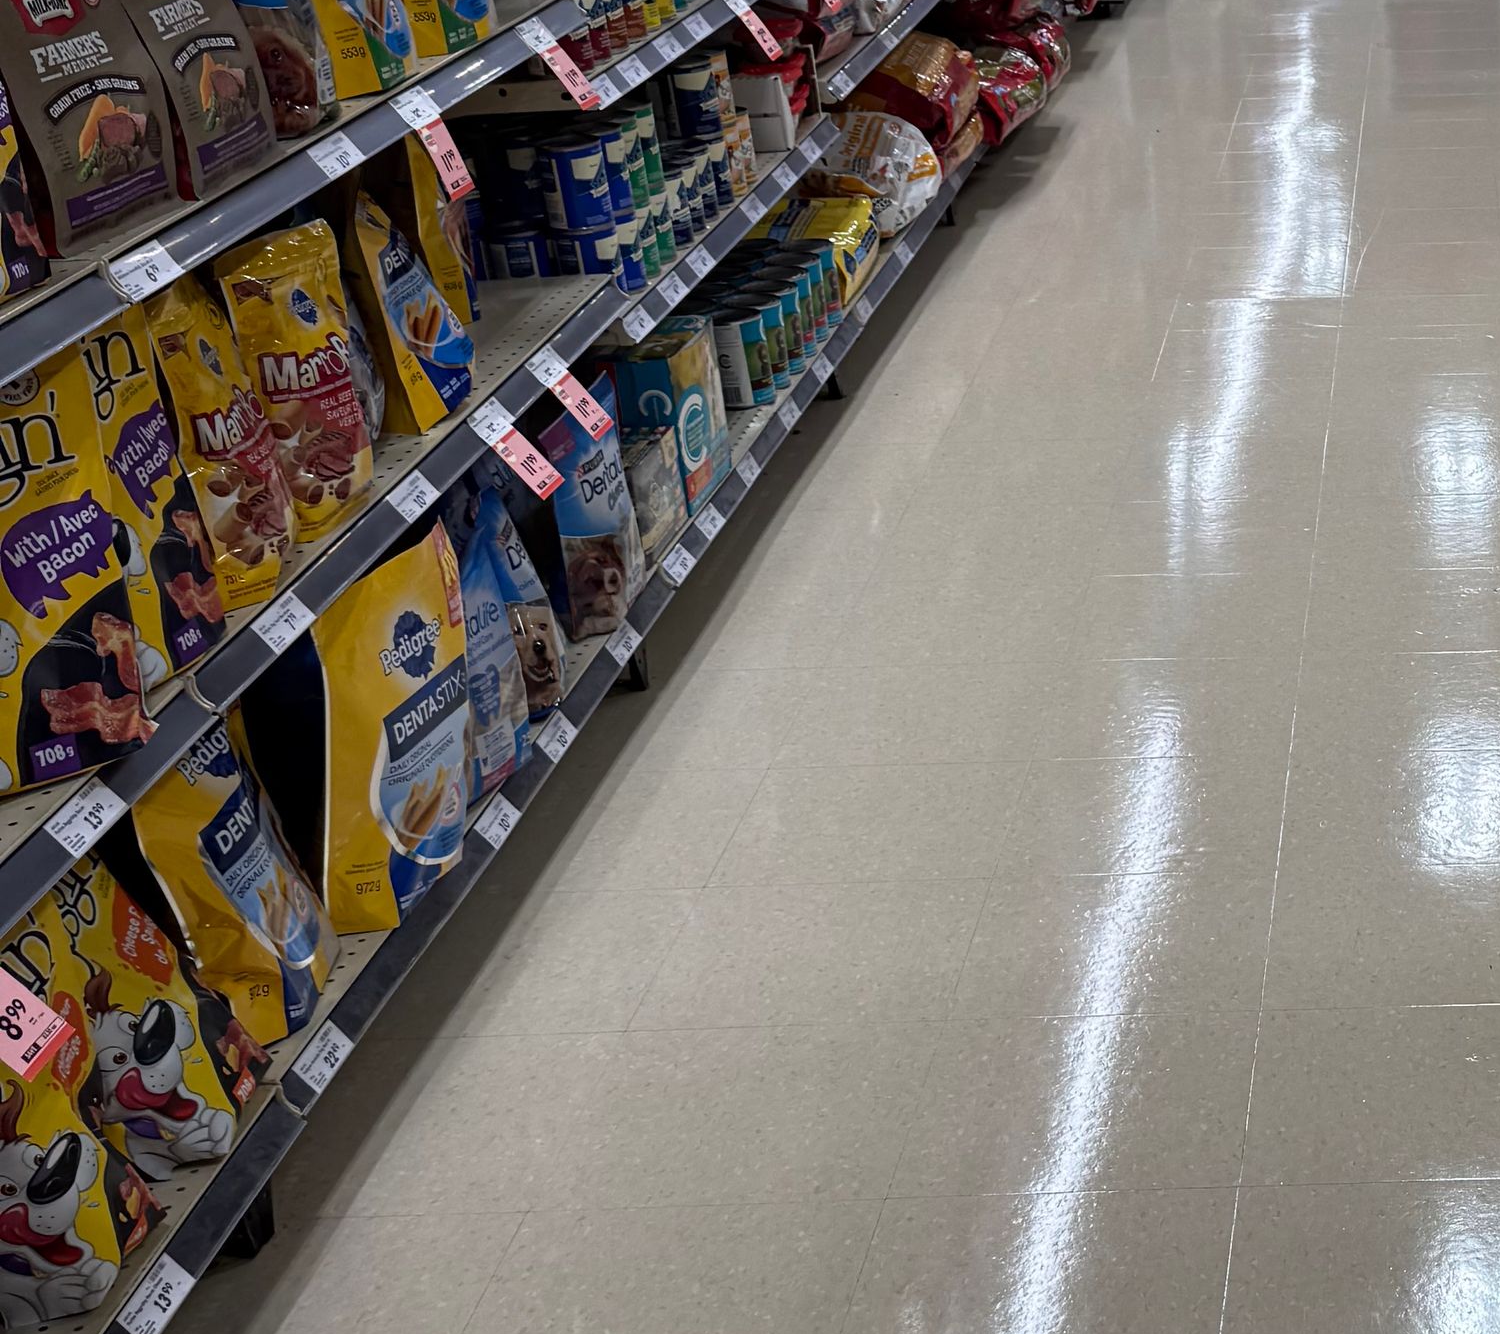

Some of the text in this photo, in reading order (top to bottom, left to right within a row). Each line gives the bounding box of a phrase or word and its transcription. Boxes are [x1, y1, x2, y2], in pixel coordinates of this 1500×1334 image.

[29, 31, 109, 74] FARMER'S
[62, 57, 101, 76] MEDLEY
[49, 78, 140, 118] GRAIN FREE SANS GRAINS
[116, 440, 140, 476] With
[142, 411, 167, 442] Avec
[135, 440, 170, 488] Bacon
[4, 531, 51, 569] With
[59, 503, 99, 538] Avec
[37, 531, 96, 584] Bacon
[379, 617, 440, 676] Pedigree
[393, 675, 464, 745] DENTASTIX
